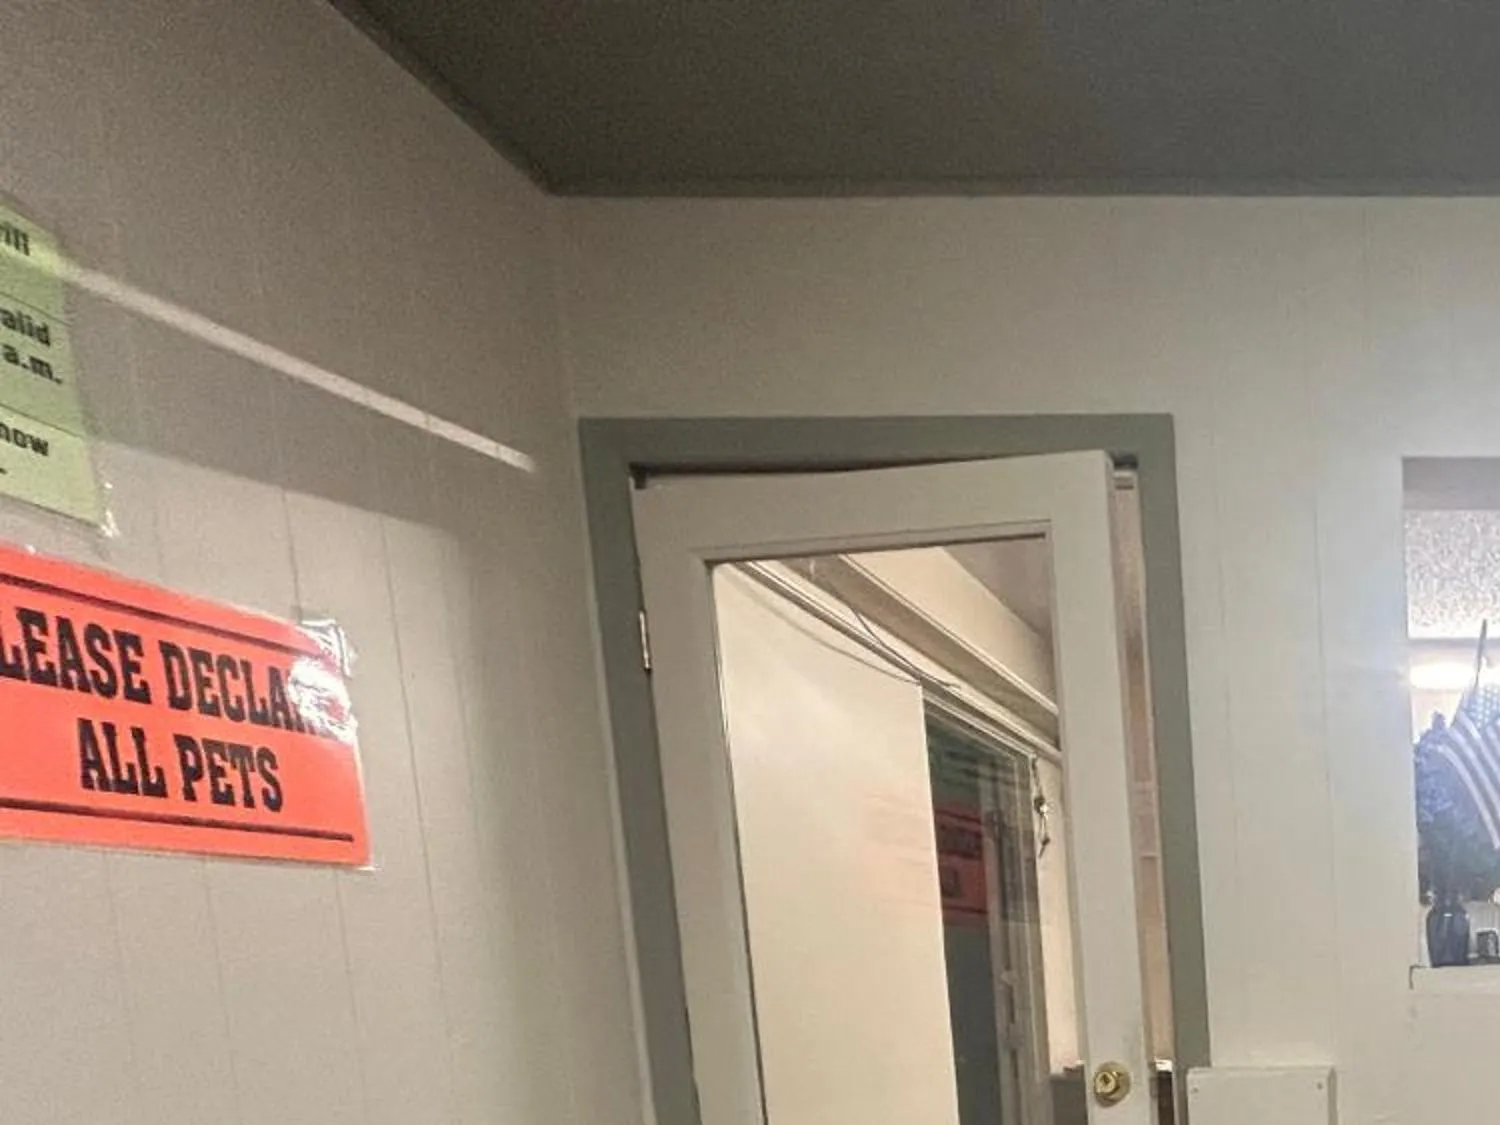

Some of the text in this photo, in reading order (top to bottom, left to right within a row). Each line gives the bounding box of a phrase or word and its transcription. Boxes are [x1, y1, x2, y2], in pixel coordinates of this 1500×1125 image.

[0, 308, 51, 347] alid
[158, 640, 338, 741] DECLA
[77, 717, 284, 813] ALL PETS
